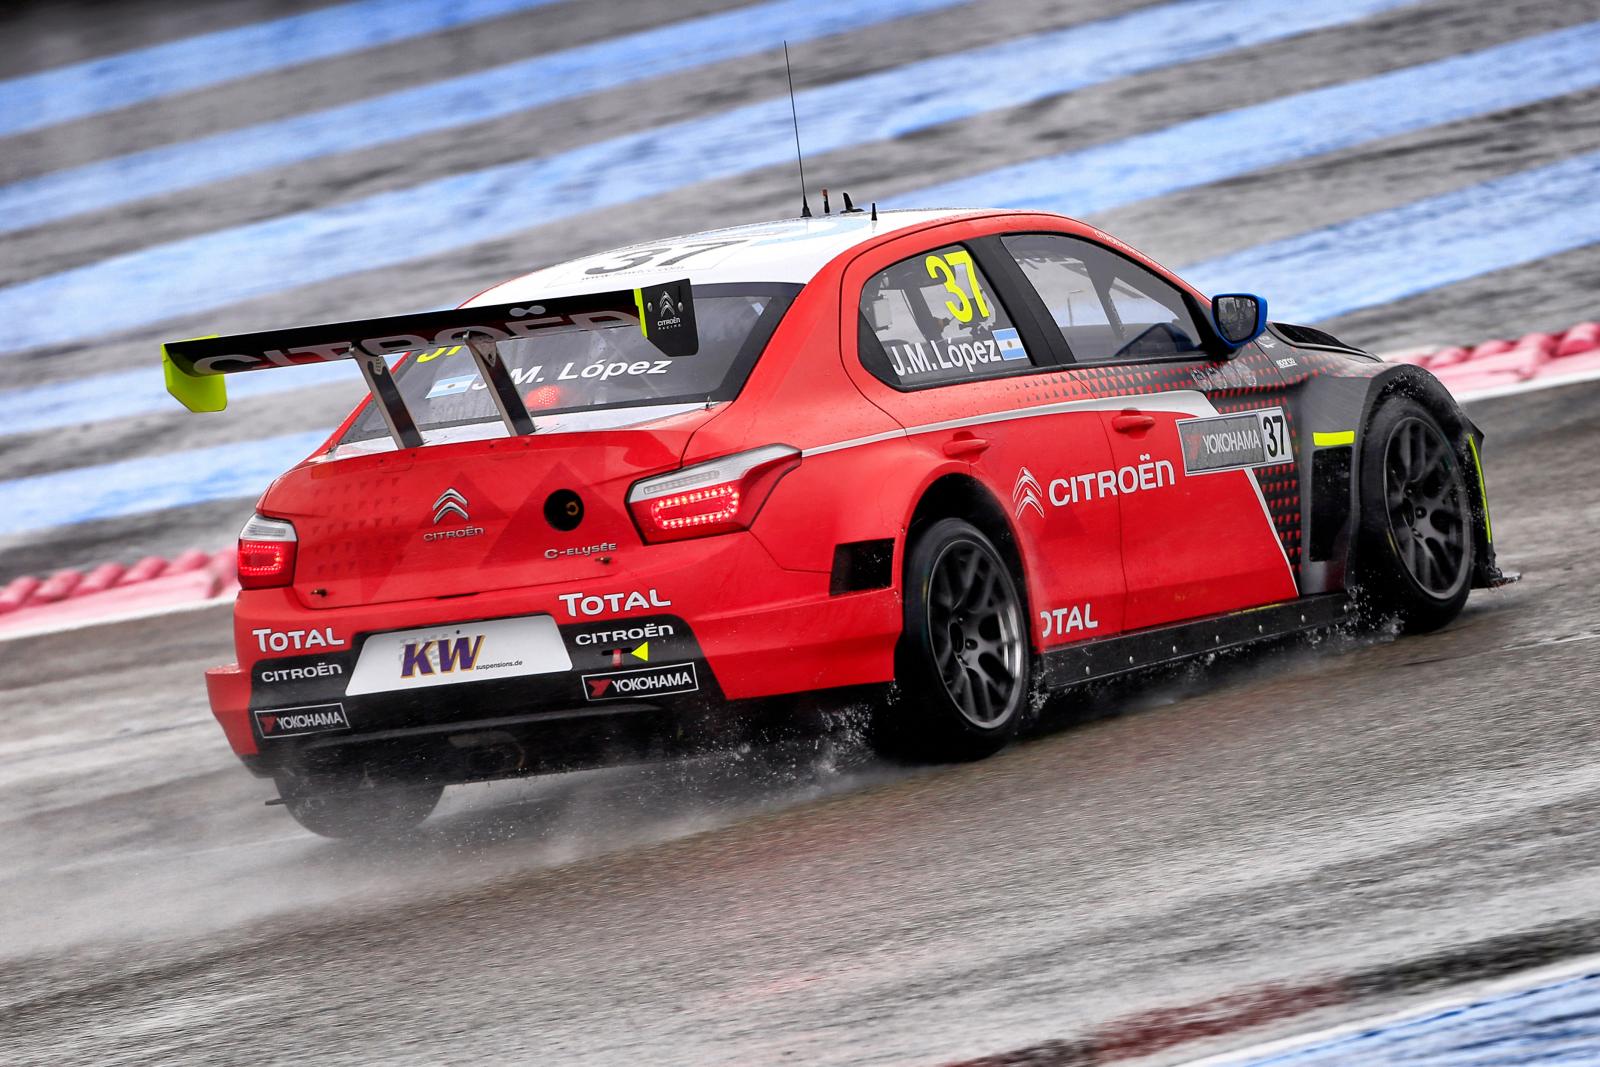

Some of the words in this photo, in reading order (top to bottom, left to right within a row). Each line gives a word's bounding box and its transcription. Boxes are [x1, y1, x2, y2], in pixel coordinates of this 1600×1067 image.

[584, 239, 749, 275] 37
[925, 250, 990, 323] 37
[557, 359, 673, 381] López
[1202, 429, 1262, 454] YOKOHAMA
[1262, 415, 1285, 458] 37
[559, 589, 672, 617] TOTAL
[252, 627, 345, 653] TOTAL
[401, 633, 486, 679] KW
[475, 659, 523, 670] suspensions.de
[612, 672, 692, 693] YOKOHAMA
[276, 711, 344, 730] YOKOHAMA
